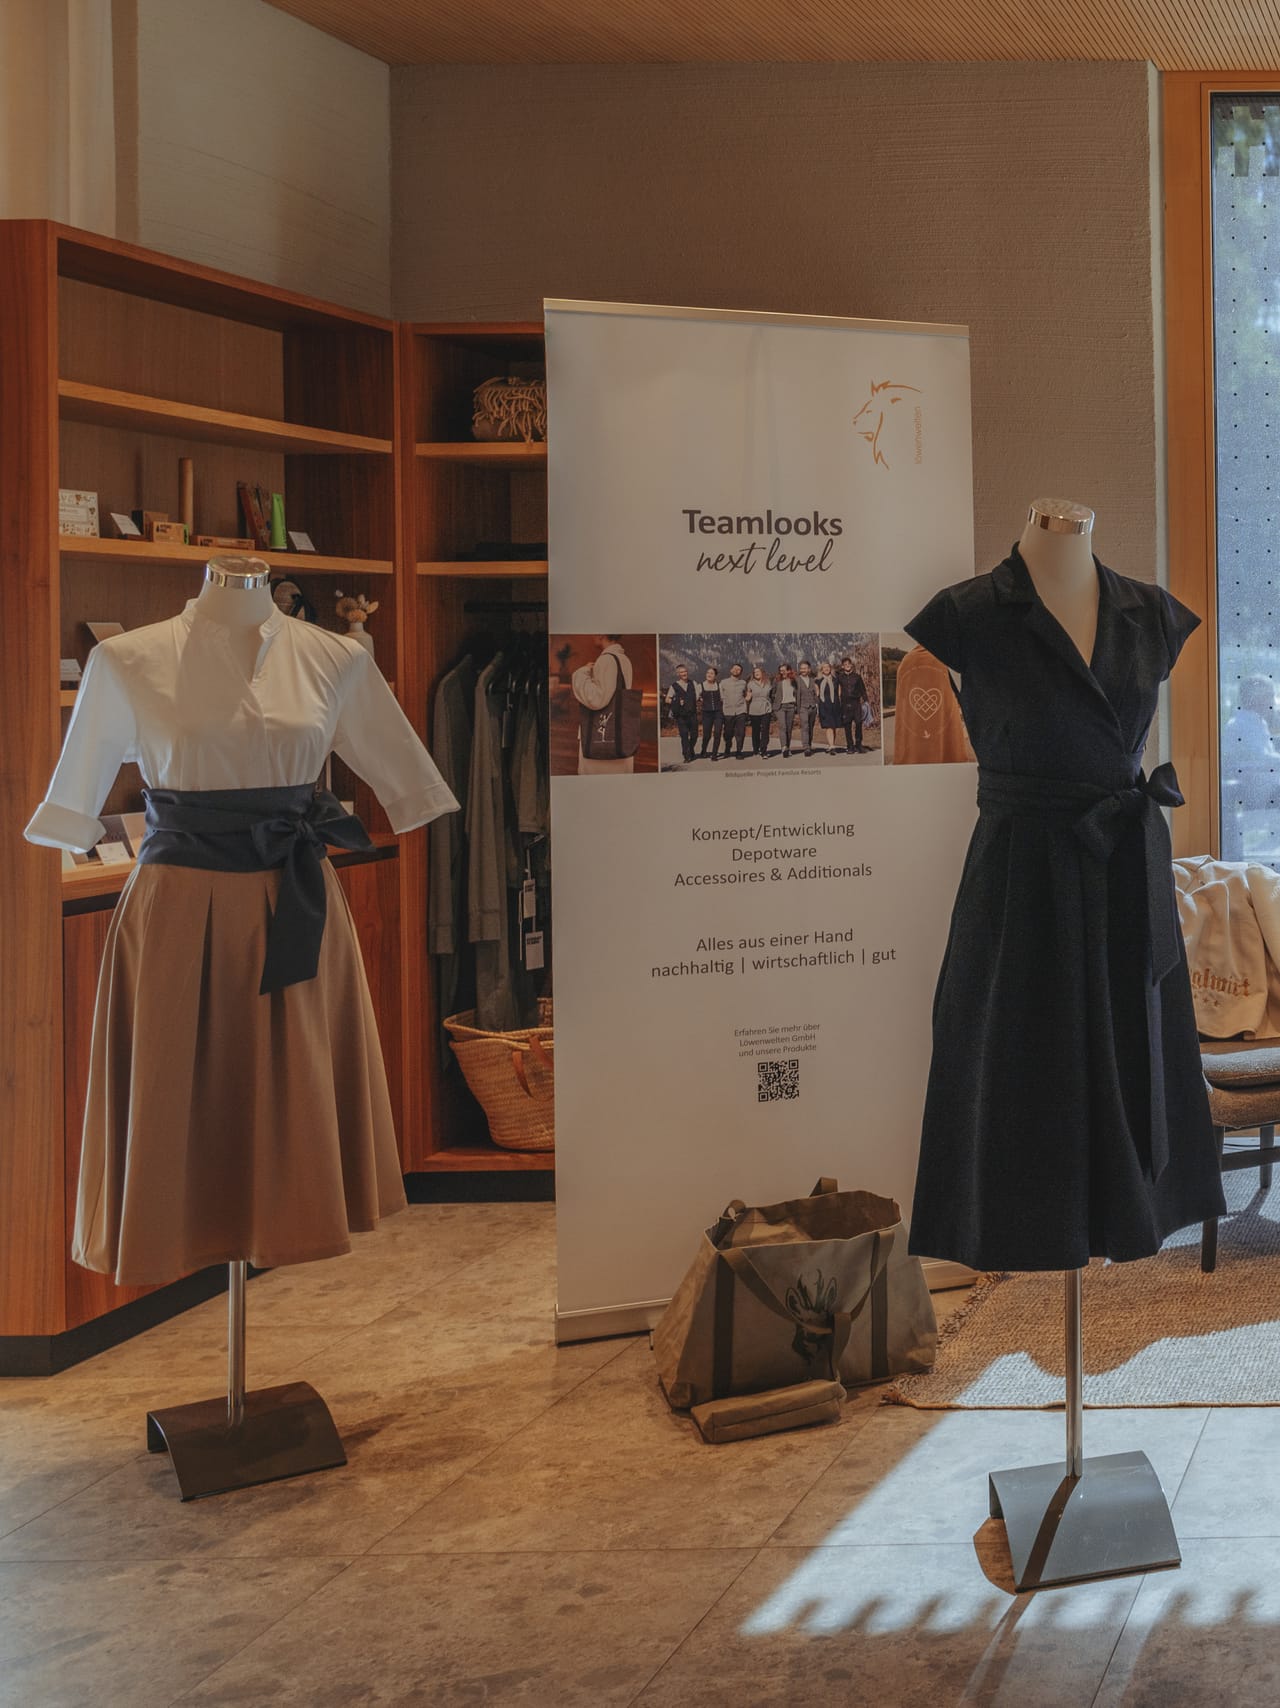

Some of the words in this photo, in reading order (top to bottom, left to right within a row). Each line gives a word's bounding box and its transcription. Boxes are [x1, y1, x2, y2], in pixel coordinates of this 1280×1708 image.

[682, 509, 843, 536] Teamlooks
[696, 542, 767, 574] next
[765, 537, 834, 573] level
[691, 822, 855, 842] Konzept/Entwicklung
[732, 847, 817, 863] Depotware
[674, 870, 766, 887] Accessoires
[770, 868, 783, 881] &
[787, 863, 873, 881] Additionals
[696, 937, 734, 952] Alles
[738, 937, 765, 949] aus
[769, 933, 810, 947] einer
[814, 928, 854, 944] Hand
[651, 959, 734, 978] nachhaltig
[752, 950, 855, 970] wirtschaftlich
[872, 948, 897, 964] gut
[734, 1027, 767, 1037] Erfahren
[768, 1026, 780, 1034] Sie
[781, 1024, 802, 1033] mehr
[803, 1023, 820, 1031] über
[791, 1033, 816, 1042] GmbH
[738, 1048, 754, 1057] und
[755, 1047, 782, 1056] unsere
[782, 1044, 817, 1053] Produkte
